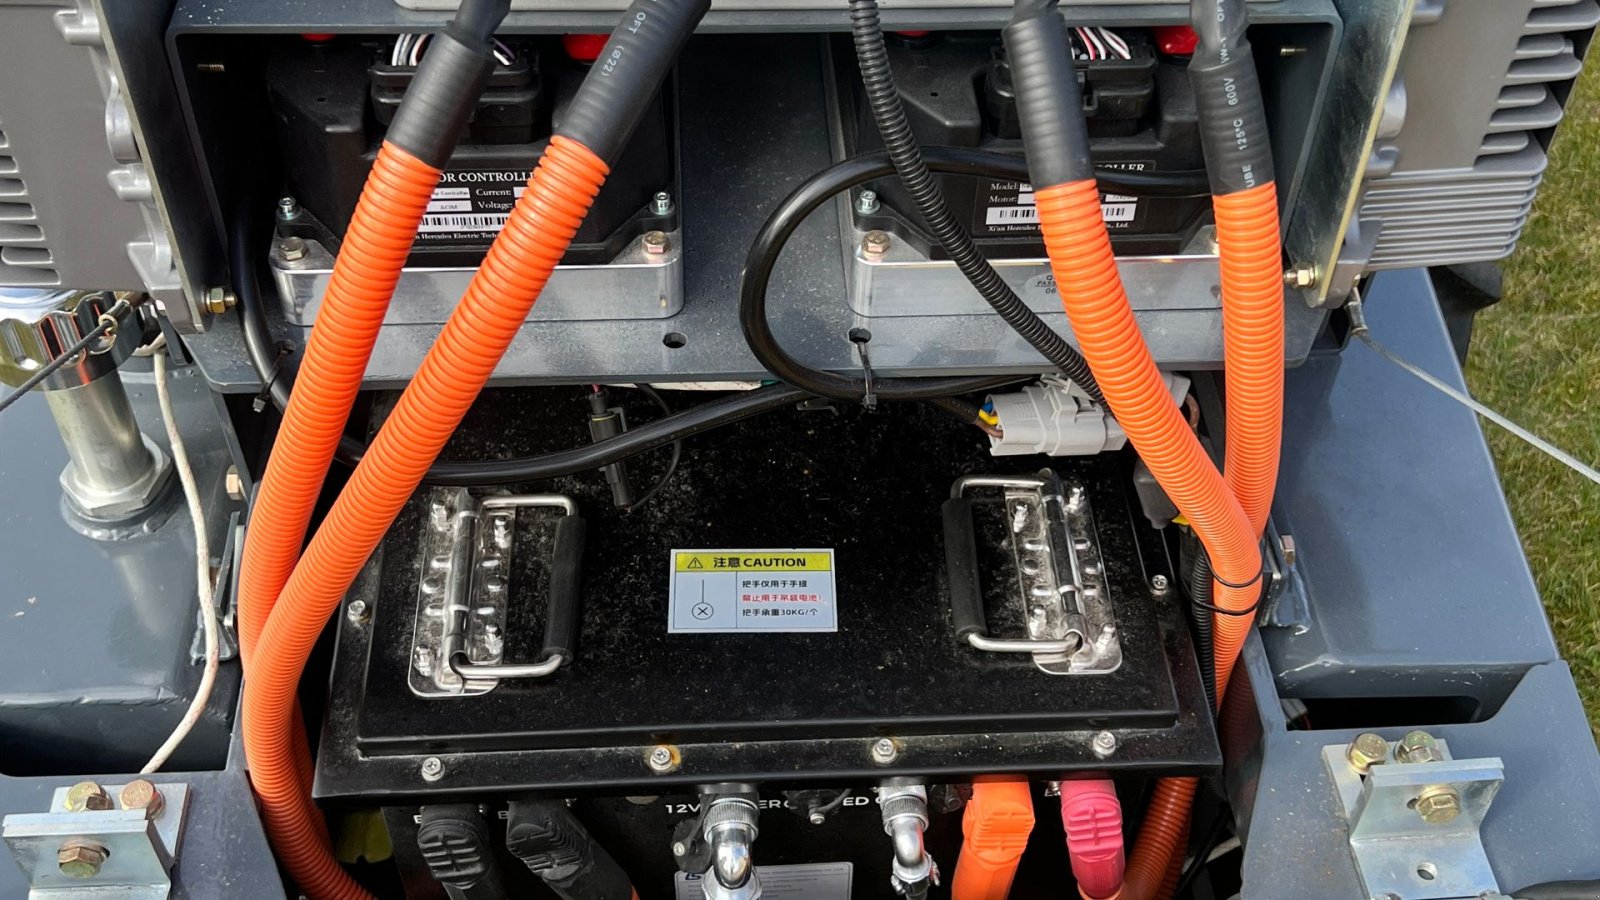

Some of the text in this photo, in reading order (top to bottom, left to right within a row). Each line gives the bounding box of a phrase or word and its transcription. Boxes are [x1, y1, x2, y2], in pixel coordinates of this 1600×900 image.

[1223, 78, 1239, 106] 600V
[459, 171, 534, 182] CONTROLL
[1242, 164, 1256, 188] UBE
[990, 182, 1020, 191] Model:
[475, 188, 512, 197] Current:
[988, 194, 1017, 204] Motor:
[478, 201, 513, 210] Voltage:
[453, 232, 480, 240] Electric
[713, 556, 807, 568] 注意 CAUTION
[742, 580, 808, 588] 把手仅用于手提
